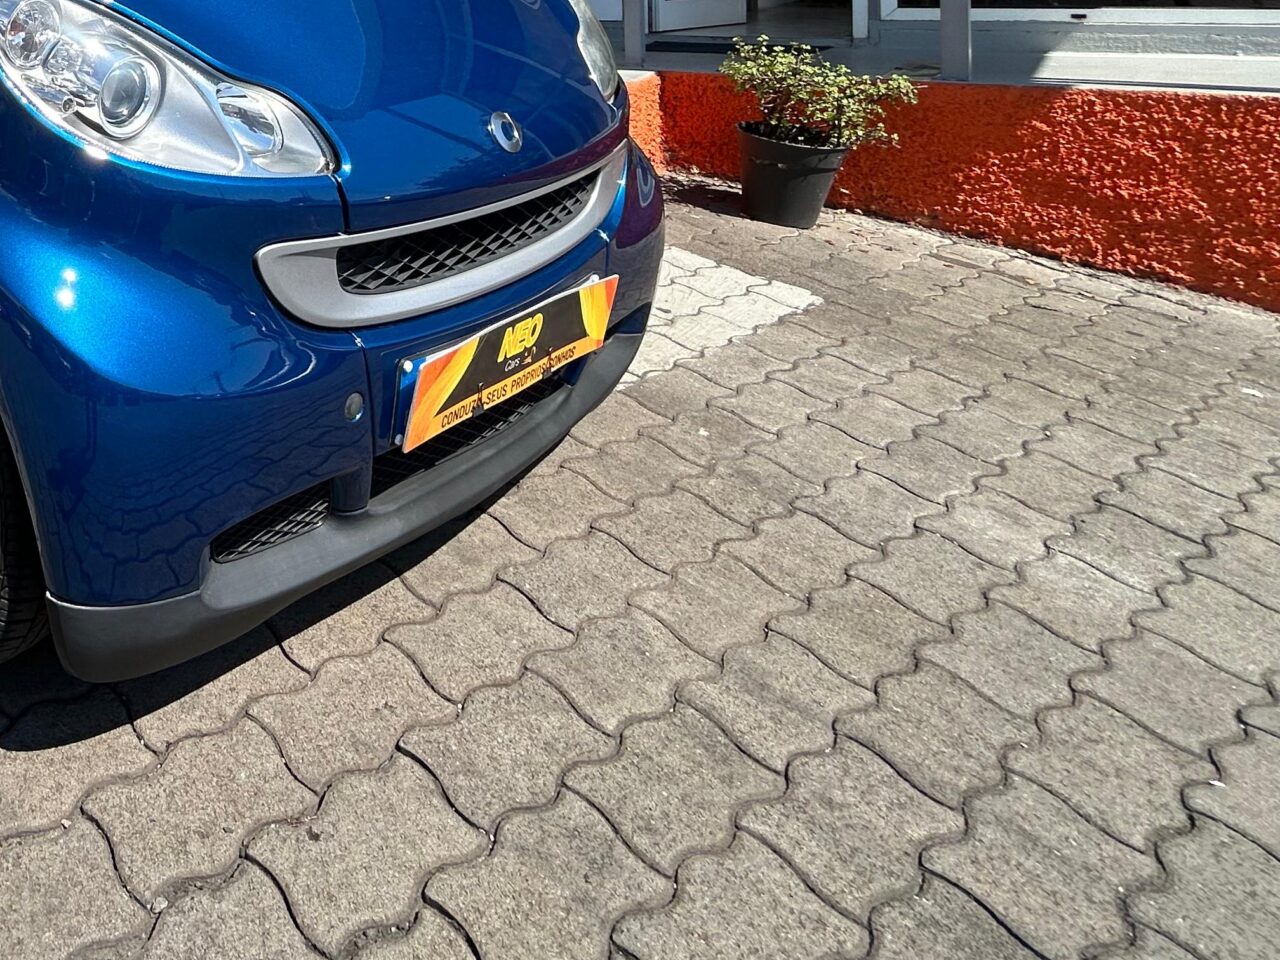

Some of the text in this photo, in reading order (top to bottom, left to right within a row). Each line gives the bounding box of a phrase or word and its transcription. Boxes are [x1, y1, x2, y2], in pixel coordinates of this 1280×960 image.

[497, 312, 544, 363] NEO
[504, 357, 521, 372] Cars
[485, 383, 508, 406] SEUS
